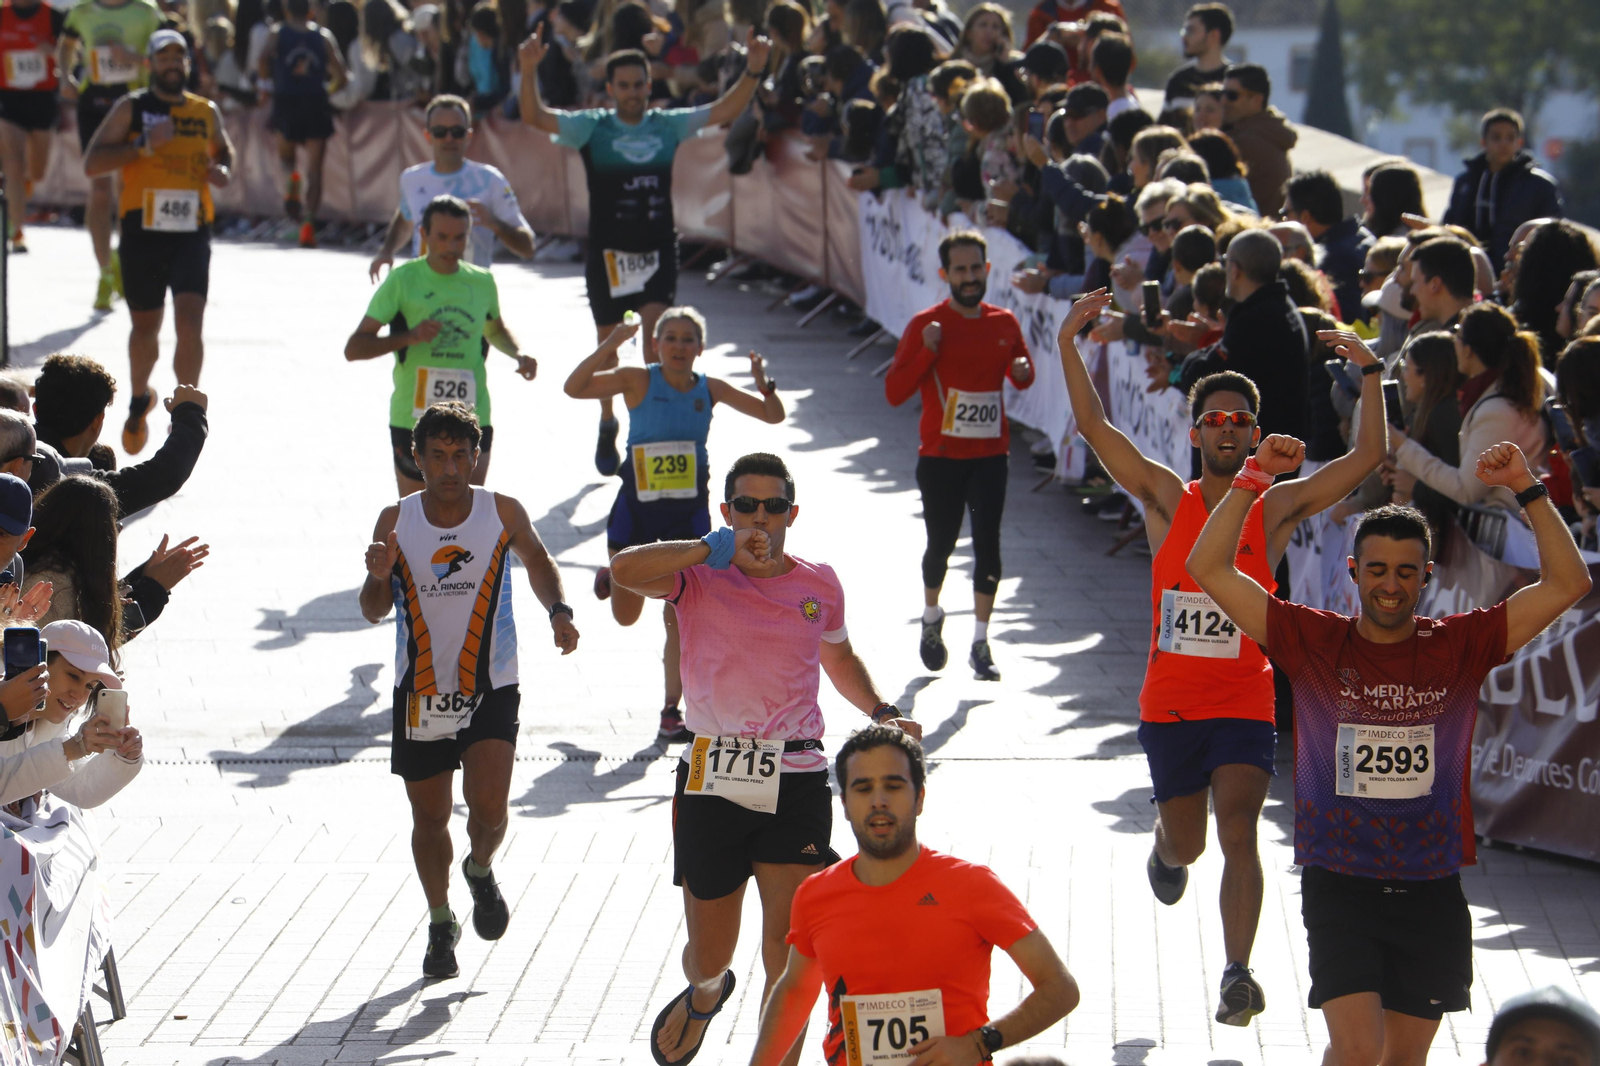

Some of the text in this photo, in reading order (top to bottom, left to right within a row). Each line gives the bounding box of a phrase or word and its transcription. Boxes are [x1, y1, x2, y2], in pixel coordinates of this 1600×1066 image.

[161, 200, 191, 218] 486
[433, 381, 467, 399] 526
[955, 404, 998, 423] 2200
[653, 455, 688, 475] 239
[440, 581, 476, 591] RINCÓN
[1174, 608, 1237, 637] 4124
[422, 690, 478, 712] 1364
[1364, 684, 1415, 698] MEDIA
[1368, 730, 1406, 739] IMDECO
[694, 754, 702, 780] CAJÓN
[708, 749, 776, 778] 1715
[1356, 744, 1430, 774] 2593
[1501, 744, 1574, 790] Deportes
[866, 1000, 906, 1010] IMDECO
[866, 1015, 930, 1051] 705
[848, 1028, 858, 1060] CAJÓN
